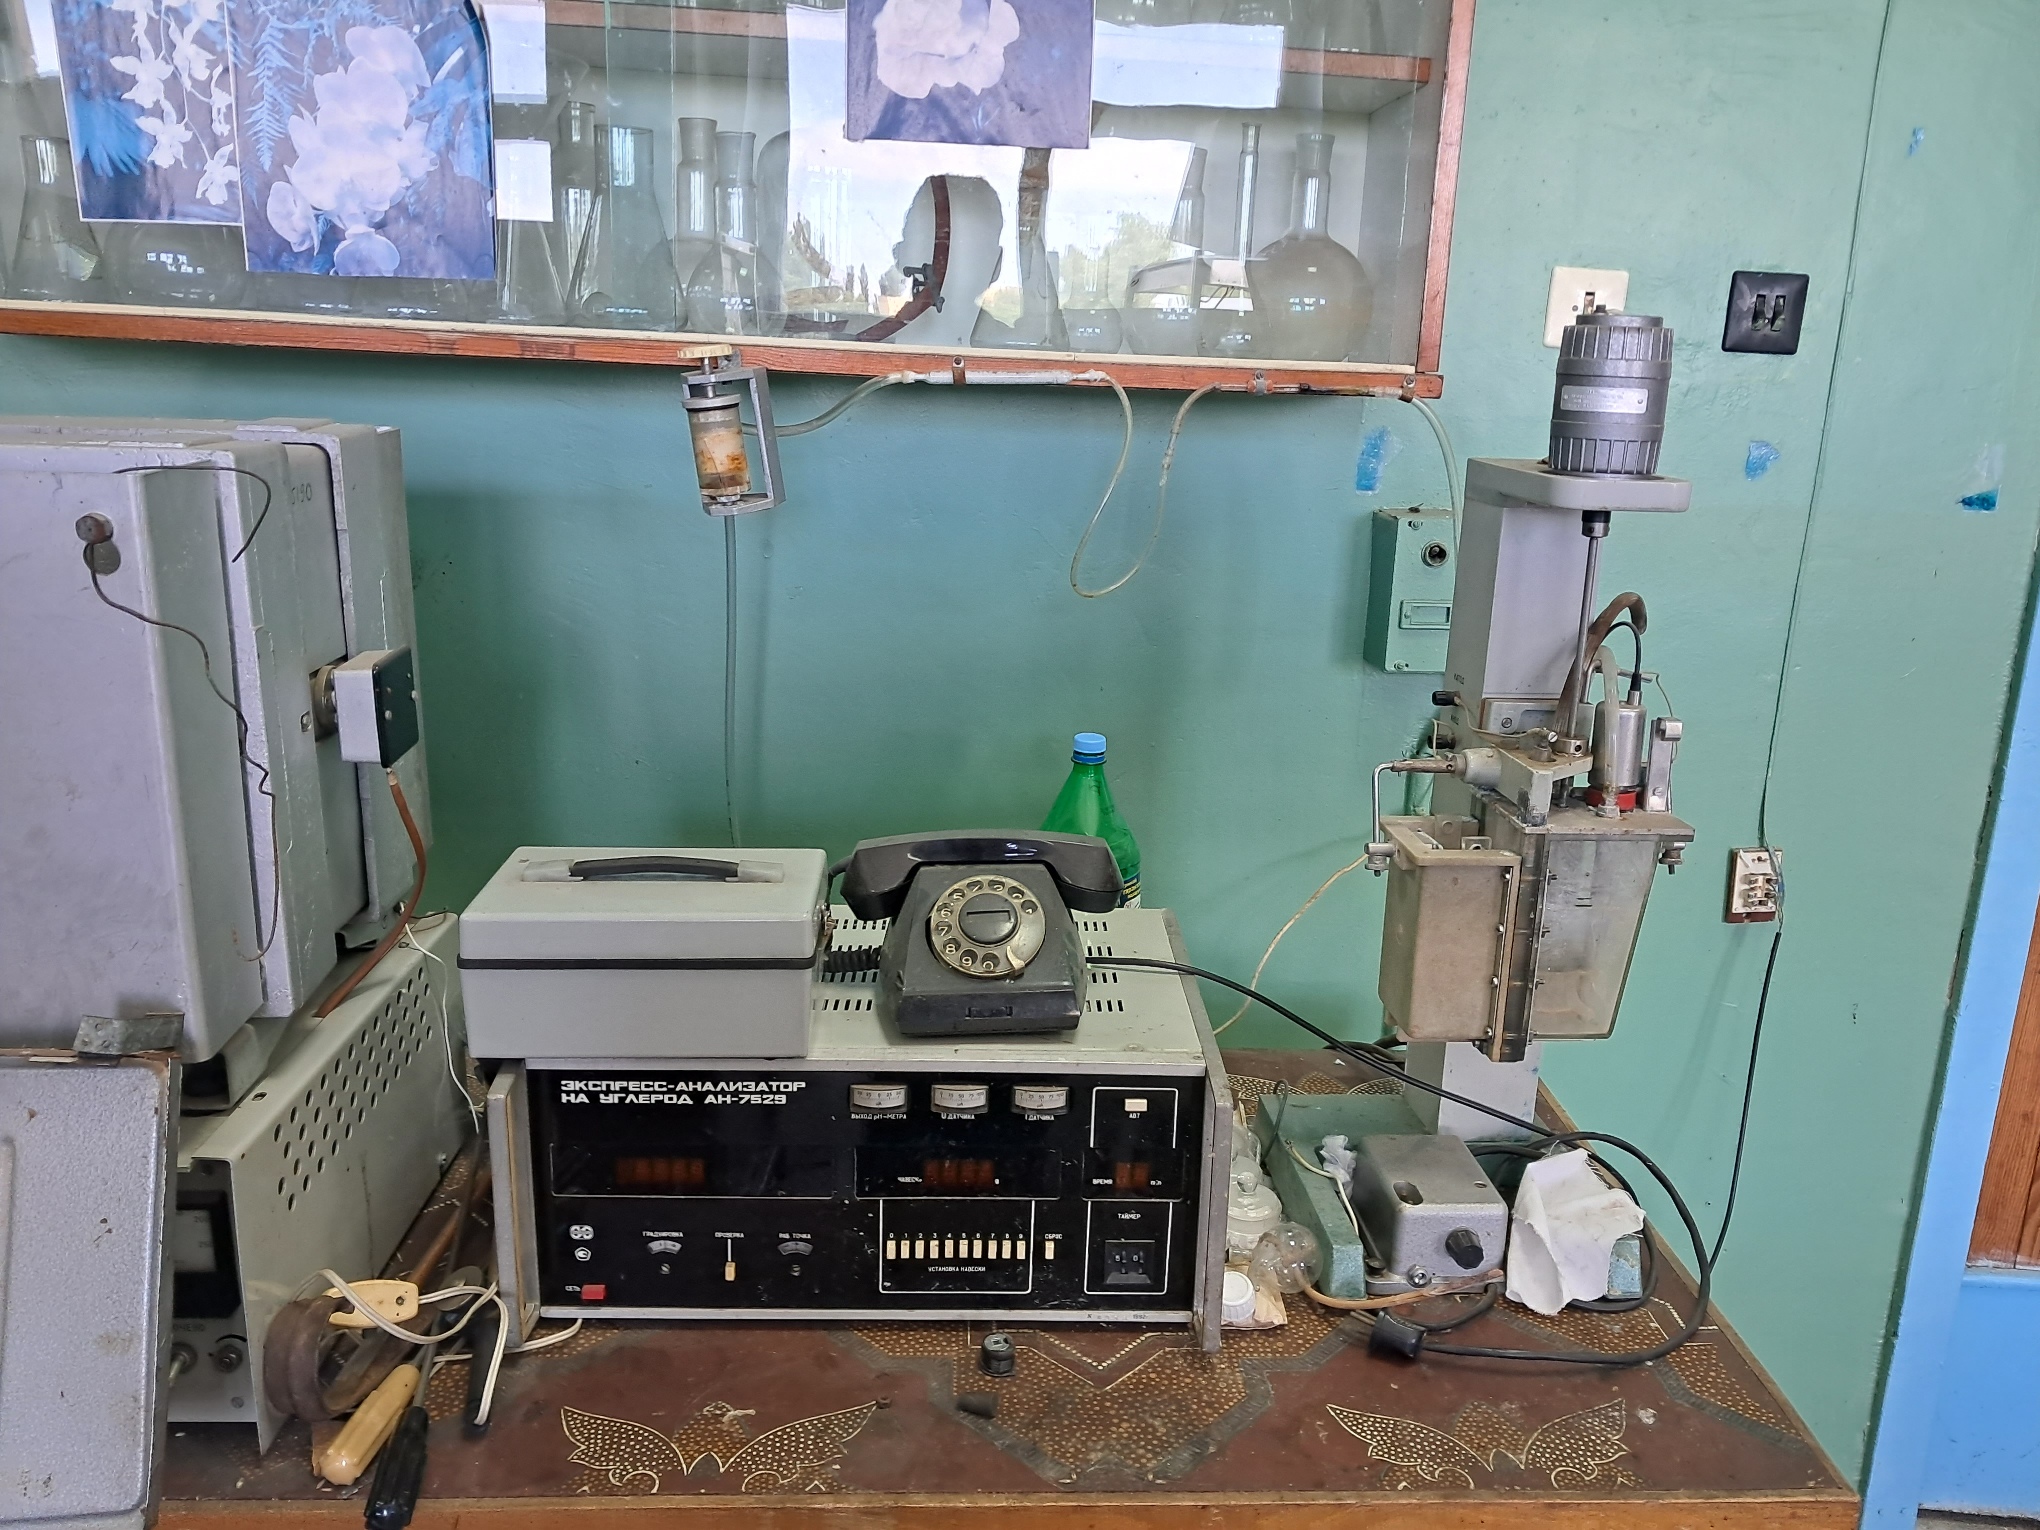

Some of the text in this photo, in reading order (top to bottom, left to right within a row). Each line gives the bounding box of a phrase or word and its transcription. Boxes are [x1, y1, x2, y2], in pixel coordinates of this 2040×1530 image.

[940, 908, 952, 918] 6
[938, 926, 949, 937] 7
[945, 944, 957, 955] 8
[962, 956, 973, 967] 9
[560, 1080, 806, 1092] ЭКСПРЕСС-АНАЛИЗАТОР
[560, 1093, 787, 1105] НА УГЛЕРОД АН-7529
[1117, 1212, 1142, 1220] ТАЙМЕР
